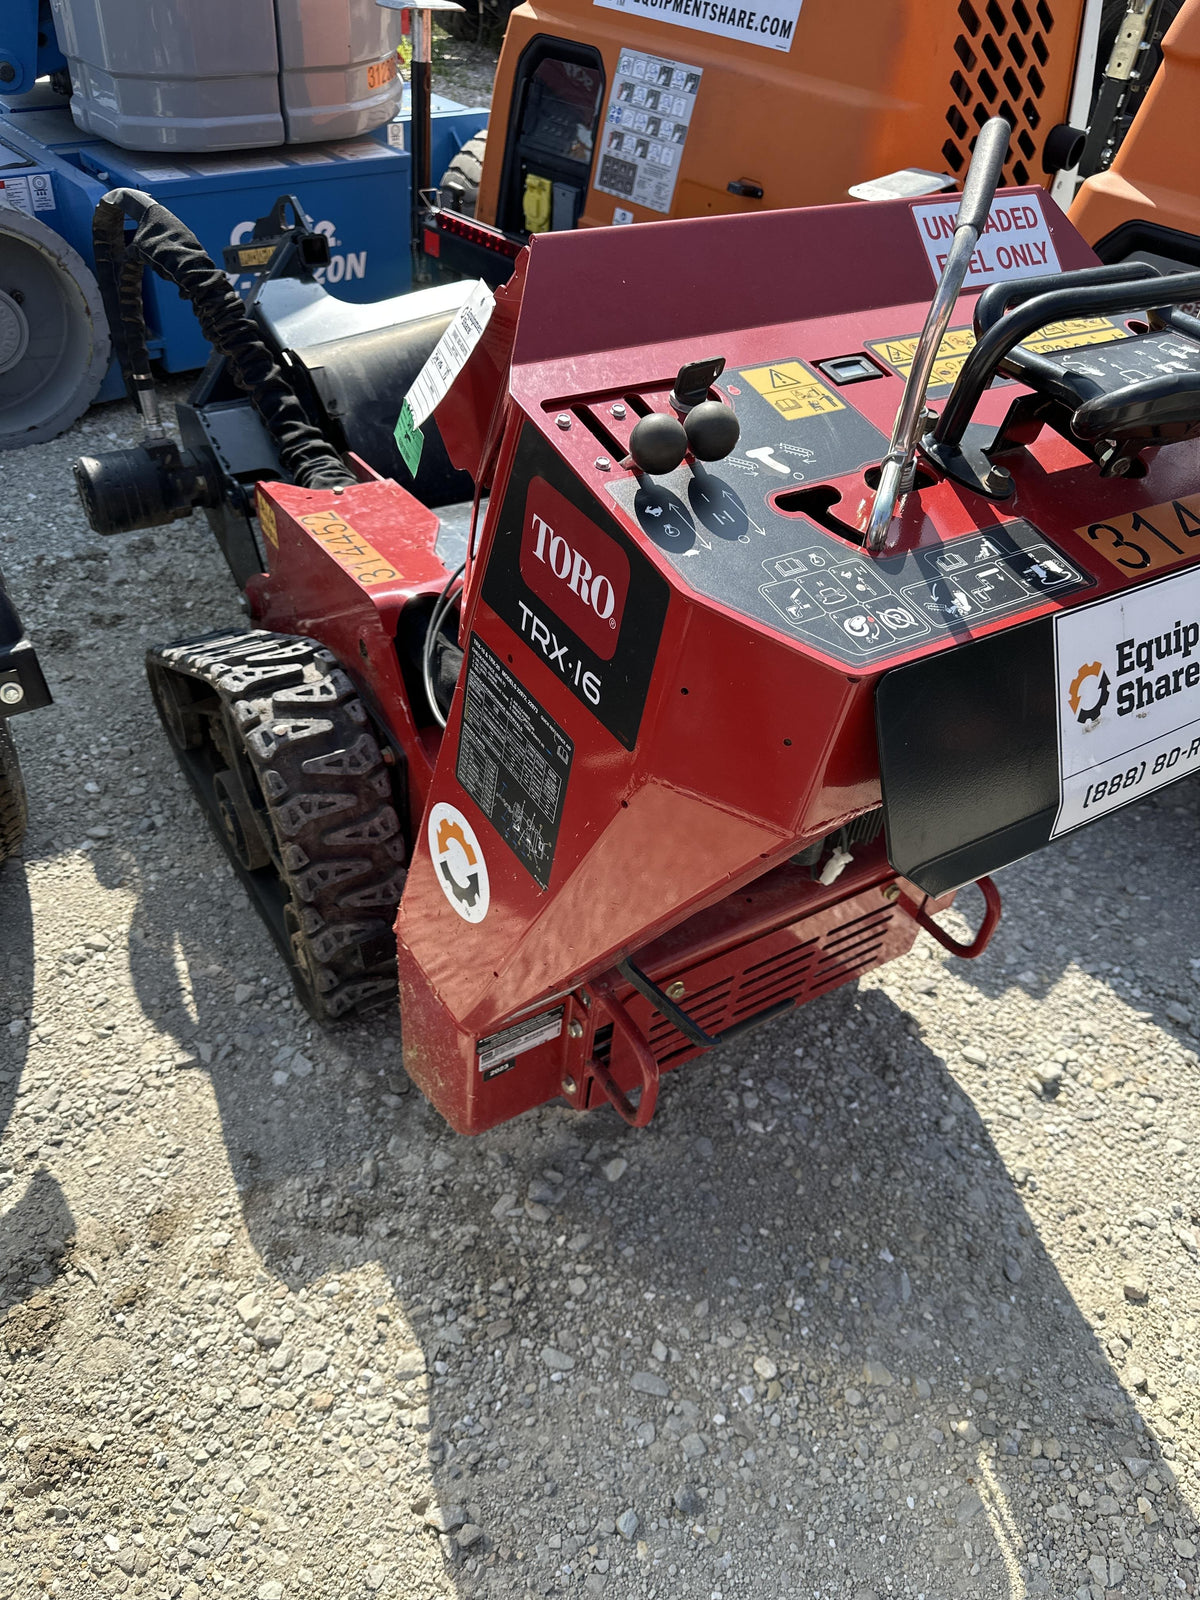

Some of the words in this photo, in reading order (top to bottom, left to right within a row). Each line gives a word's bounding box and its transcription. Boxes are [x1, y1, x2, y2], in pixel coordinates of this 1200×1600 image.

[633, 0, 793, 39] QUIPMENTSHARE.COM
[923, 206, 1038, 240] UNADED
[936, 250, 994, 276] FEL
[996, 241, 1048, 270] ONLY
[301, 512, 396, 583] 314452
[532, 513, 615, 619] TORO
[1116, 620, 1200, 677] Equip
[502, 670, 517, 690] MODELS
[1116, 661, 1200, 717] Share
[1083, 761, 1146, 808] (888)
[1152, 737, 1200, 775] 80-R
